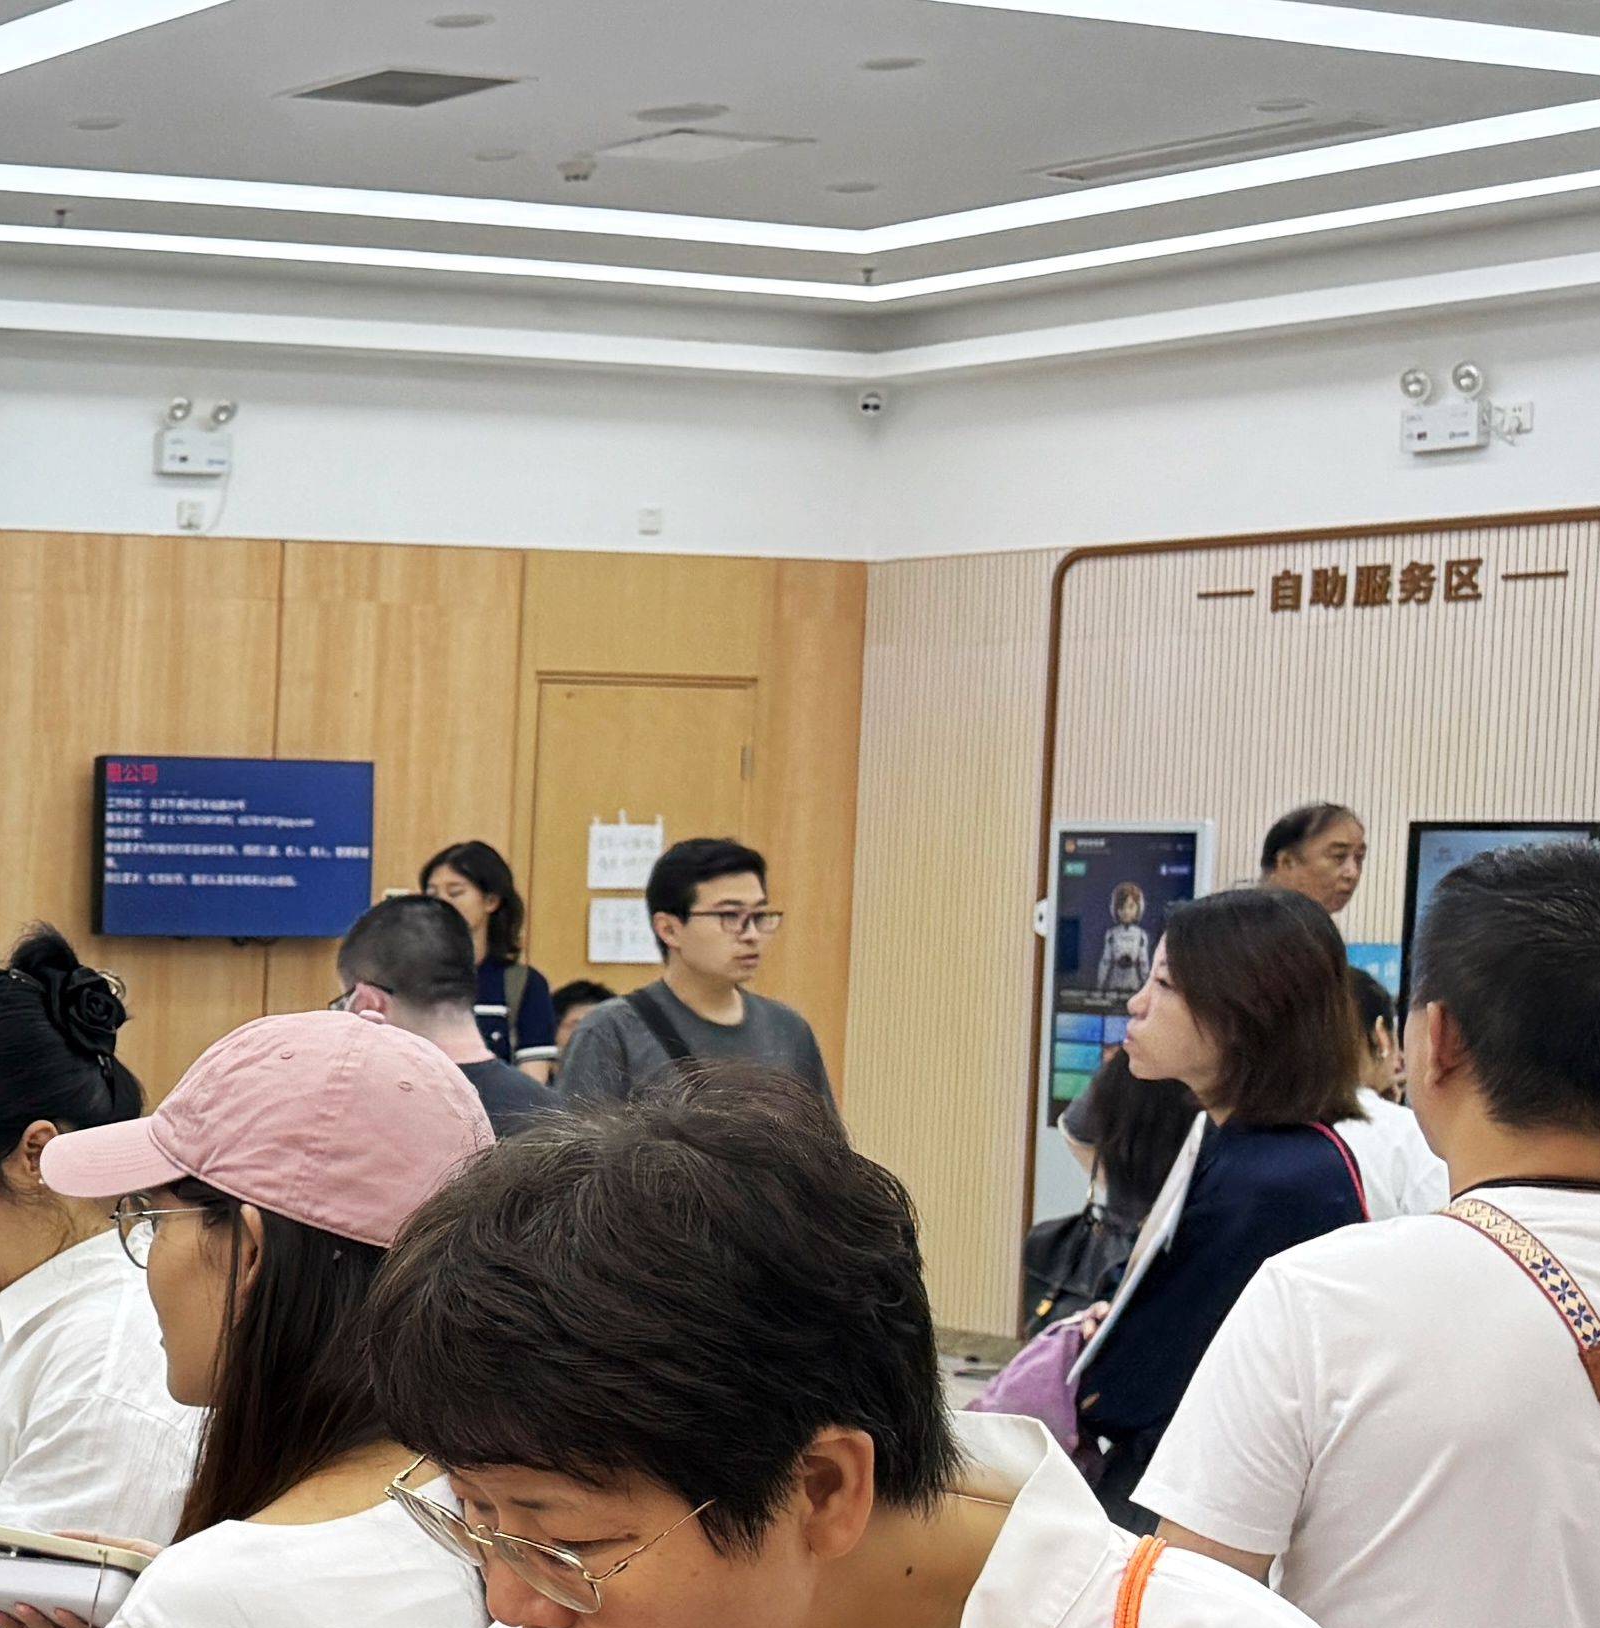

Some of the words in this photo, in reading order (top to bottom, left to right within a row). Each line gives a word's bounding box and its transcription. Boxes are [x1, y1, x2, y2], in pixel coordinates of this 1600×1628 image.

[1270, 557, 1484, 615] 自助服务区
